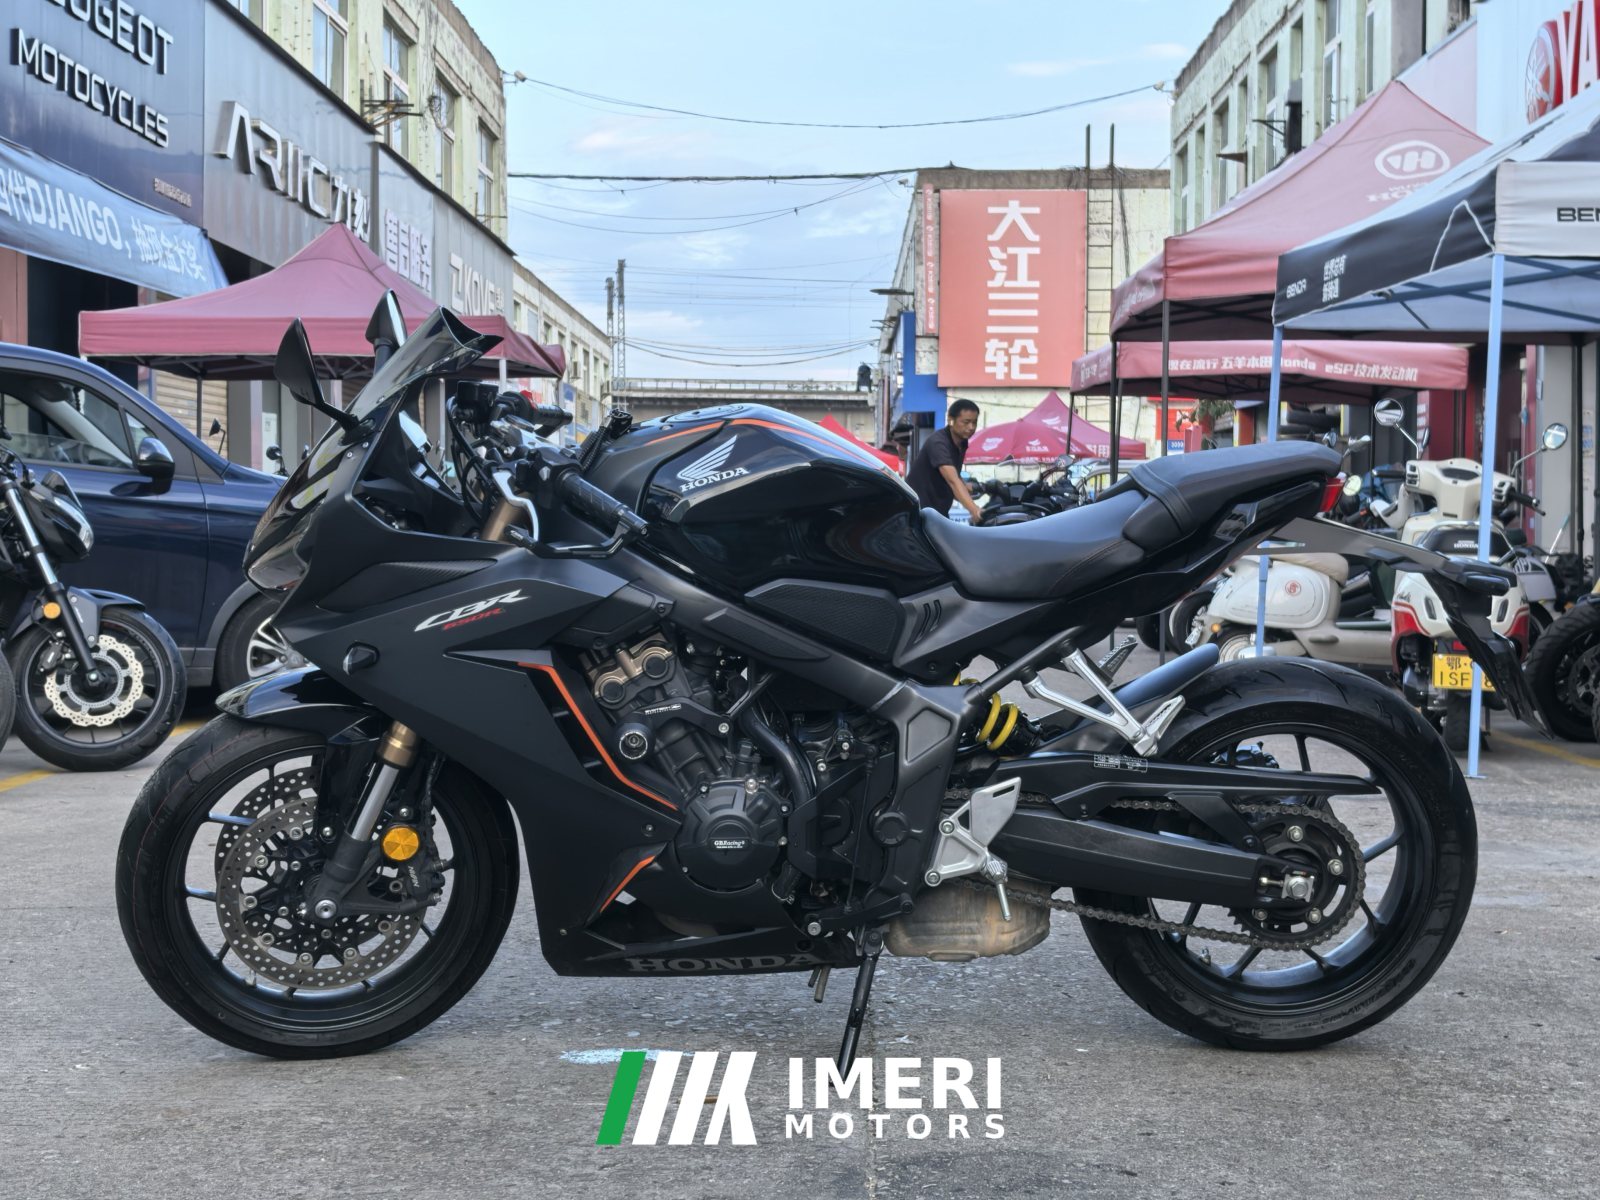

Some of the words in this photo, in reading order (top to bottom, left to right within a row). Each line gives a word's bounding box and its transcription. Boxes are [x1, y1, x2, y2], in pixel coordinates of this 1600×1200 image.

[18, 28, 169, 148] MOTOCYCLES
[1557, 207, 1600, 222] BE
[984, 199, 1040, 380] 大江三轮
[1221, 356, 1262, 370] 五羊本田
[1280, 357, 1316, 370] onda
[680, 467, 750, 493] HONDA
[624, 952, 826, 973] HONDA
